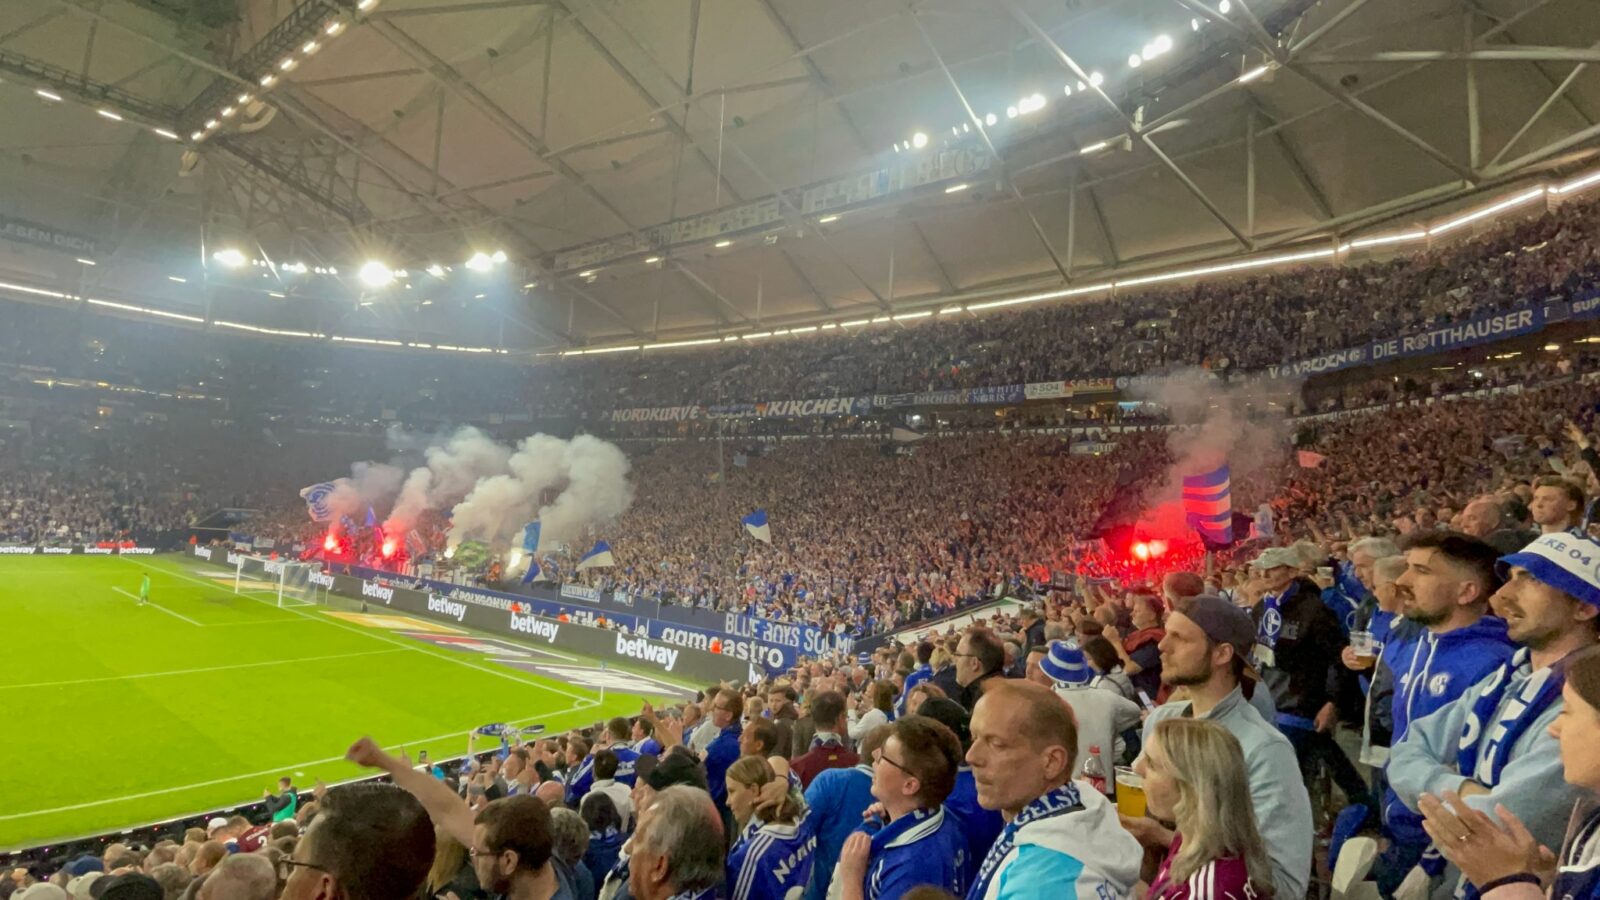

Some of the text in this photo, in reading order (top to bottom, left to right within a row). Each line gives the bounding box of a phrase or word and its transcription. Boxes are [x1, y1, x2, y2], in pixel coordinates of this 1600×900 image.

[1373, 340, 1398, 360] DIE
[1293, 351, 1346, 375] VREDEN
[611, 405, 700, 422] NORDKURVE
[194, 544, 212, 561] betway
[308, 568, 335, 590] betway
[362, 579, 394, 604] betway
[428, 594, 467, 621] betway
[510, 611, 559, 643] betway
[616, 632, 678, 672] betway
[725, 612, 761, 640] BLUE
[762, 622, 801, 647] BOYS
